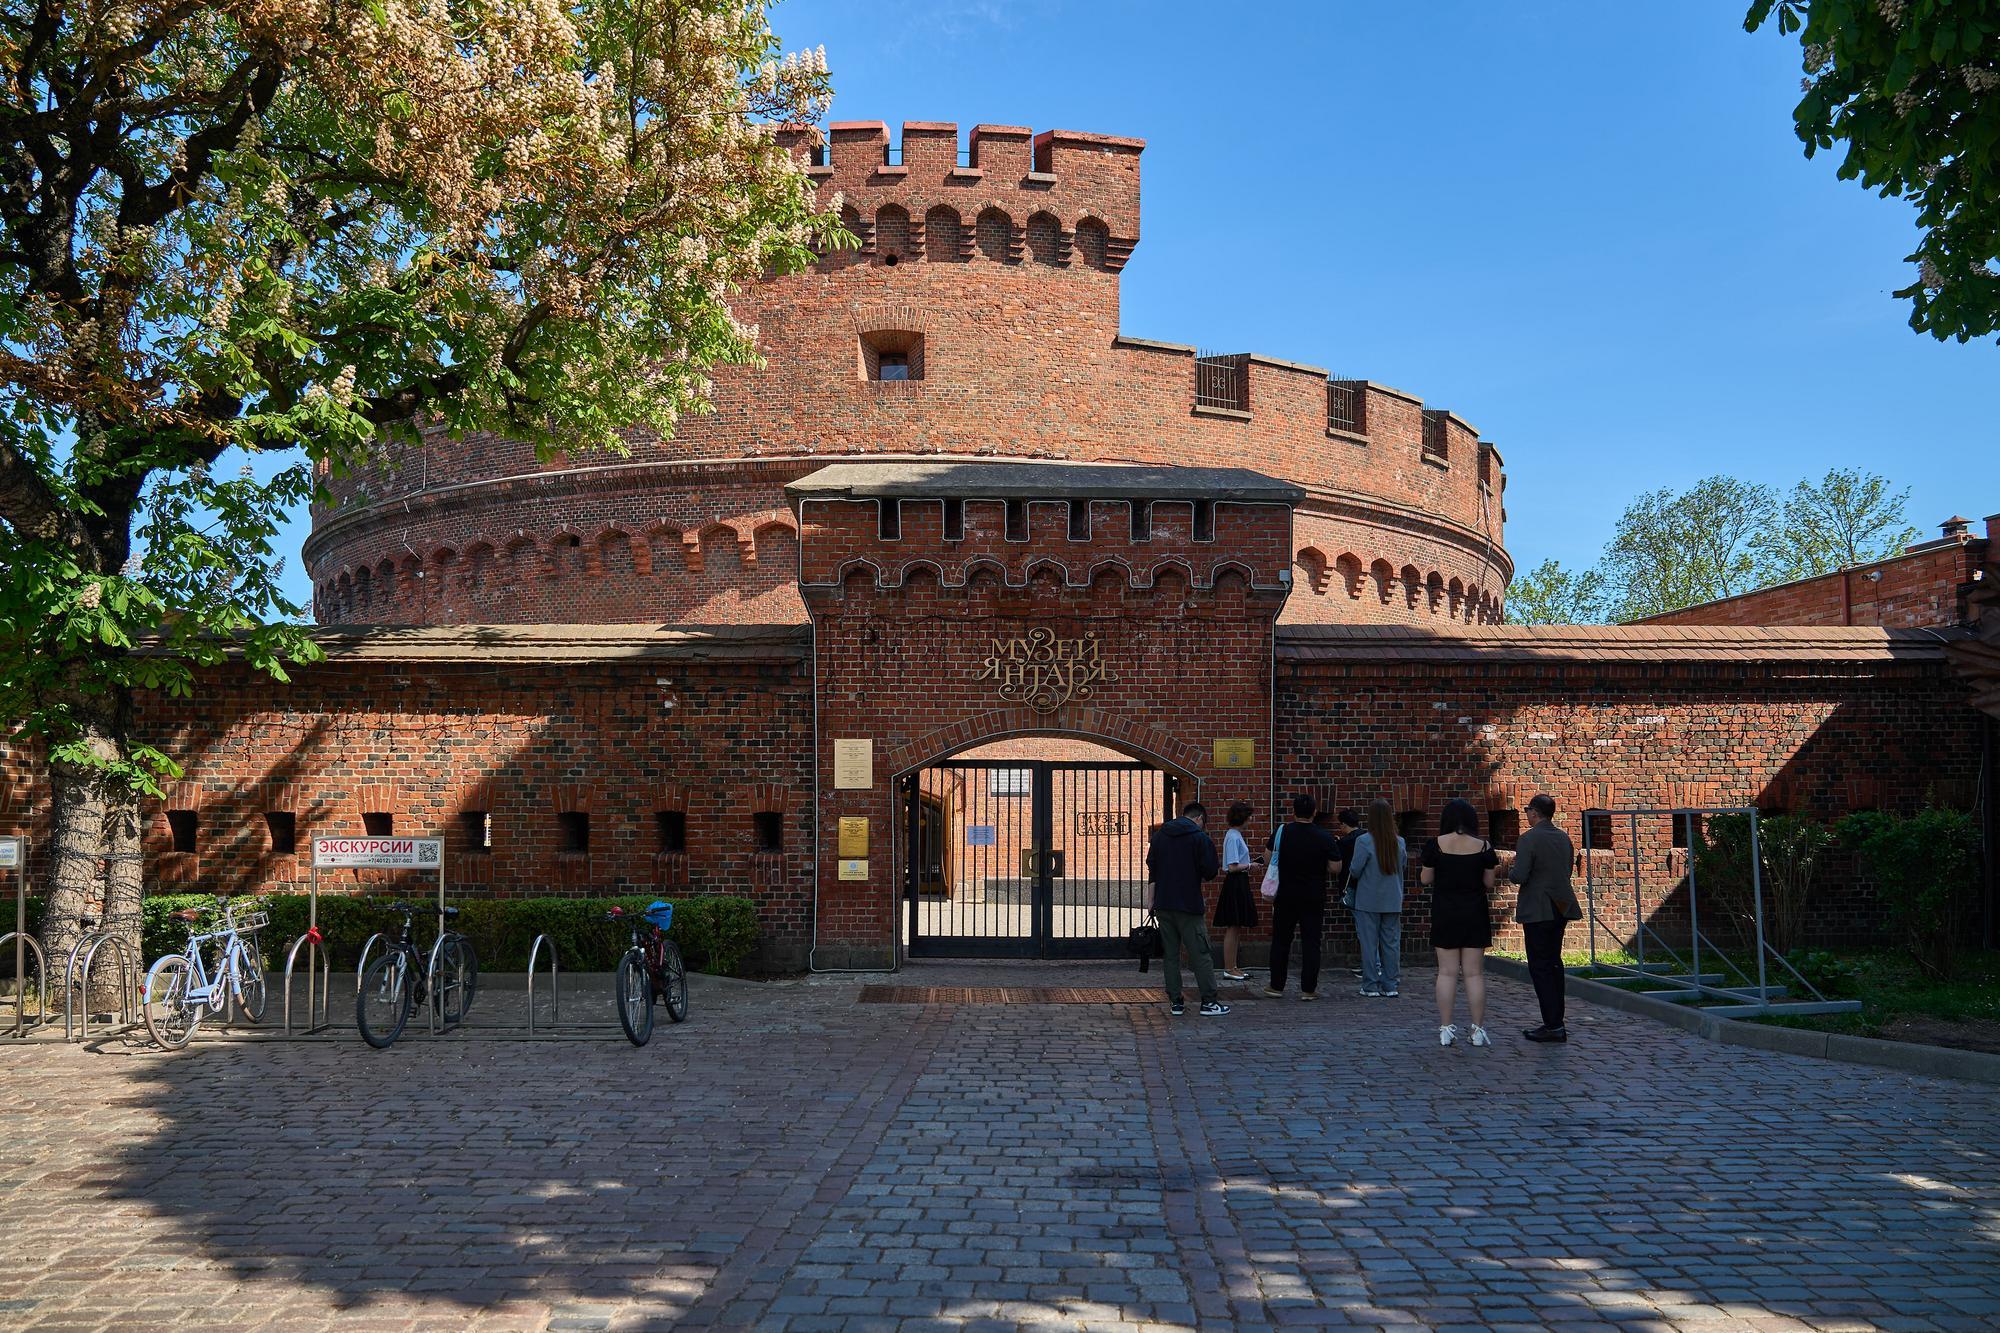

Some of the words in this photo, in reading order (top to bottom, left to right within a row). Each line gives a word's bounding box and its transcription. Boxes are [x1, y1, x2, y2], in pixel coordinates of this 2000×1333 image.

[990, 627, 1100, 665] МУЗЕЙ
[972, 654, 1119, 715] ЯНТАРЯ
[319, 841, 413, 853] ЭКСКУРСИИ
